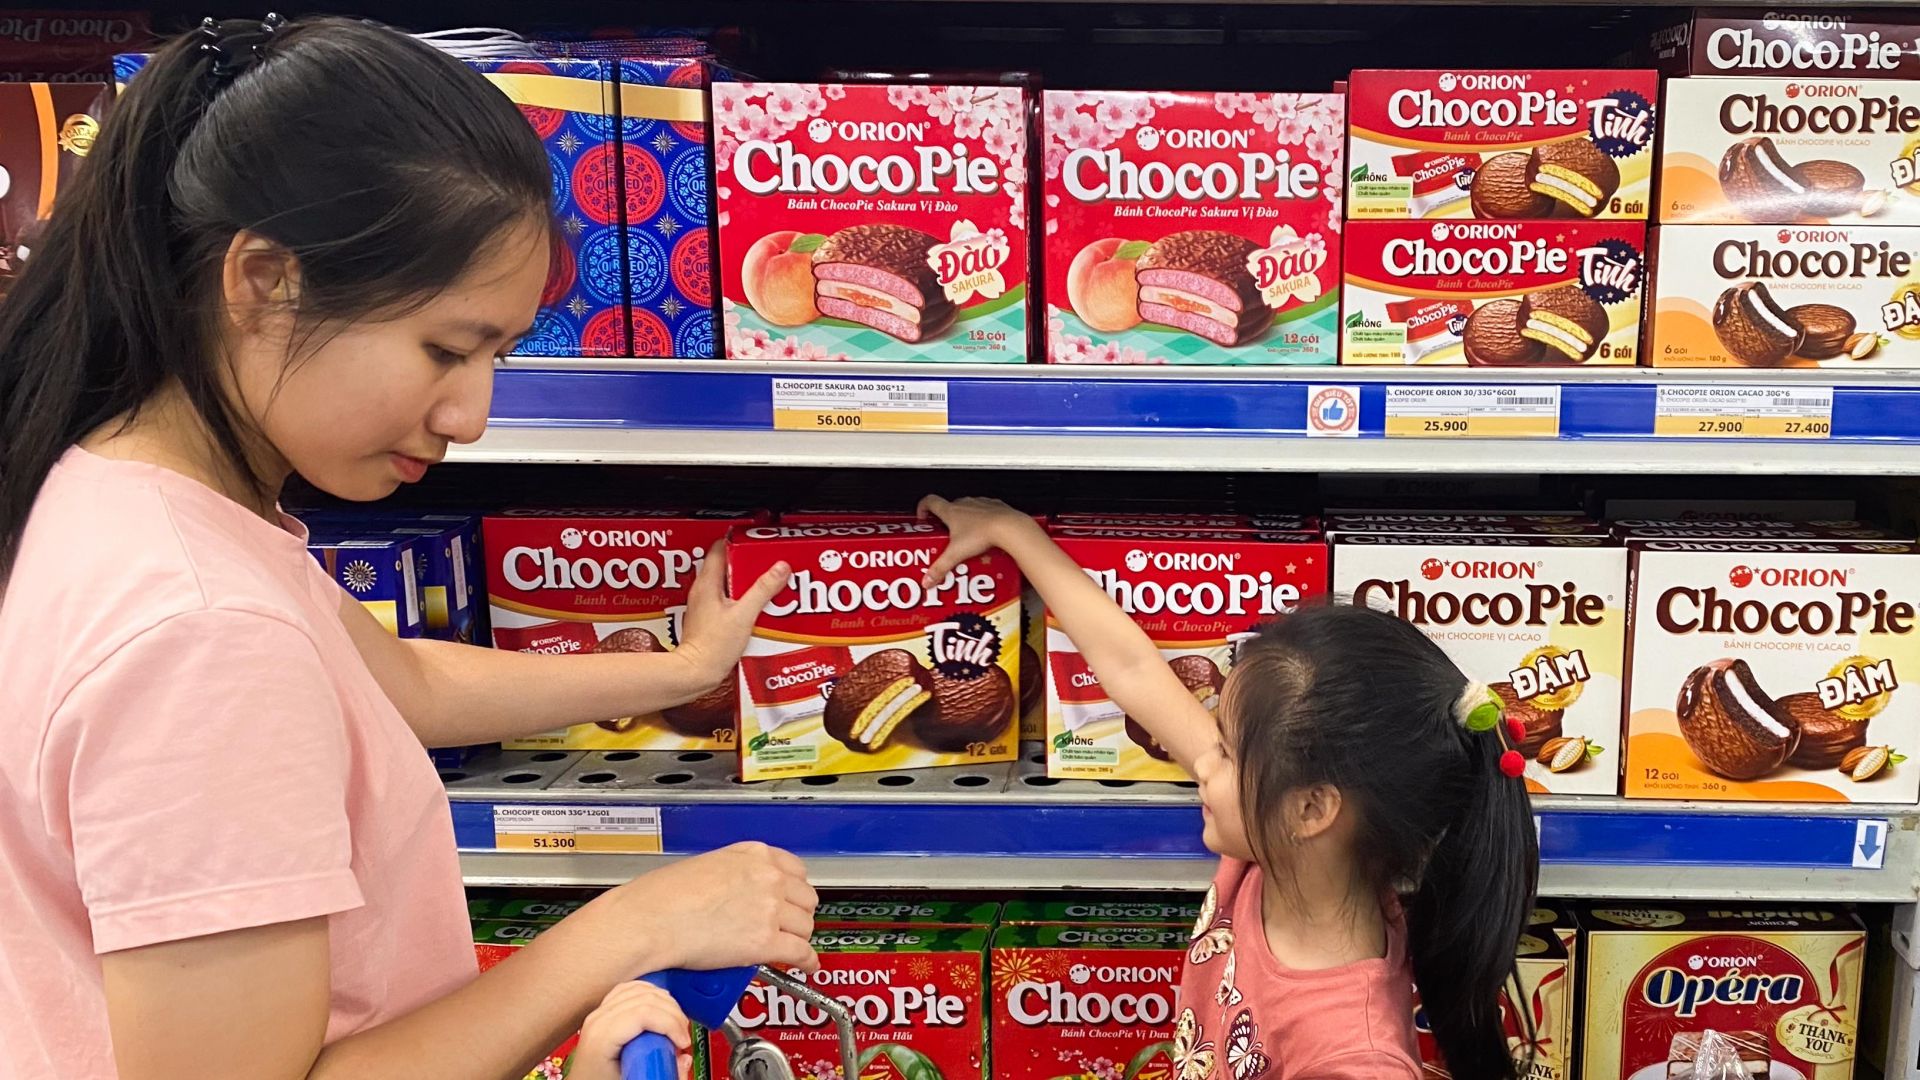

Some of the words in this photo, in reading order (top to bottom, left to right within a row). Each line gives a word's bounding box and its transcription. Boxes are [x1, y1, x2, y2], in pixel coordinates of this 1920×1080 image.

[1706, 27, 1901, 70] ChocoPie
[1462, 75, 1526, 90] ORION
[1804, 85, 1858, 97] ORION
[1388, 89, 1577, 128] ChocoPie
[1719, 94, 1920, 134] ChocoPie
[839, 121, 924, 142] ORION
[1166, 128, 1249, 149] ORION
[1475, 131, 1522, 141] ChocoPie
[733, 140, 999, 194] ChocoPie
[1063, 148, 1319, 201] ChocoPie
[1413, 157, 1465, 182] ChocoPie
[787, 197, 817, 210] Bánh
[820, 198, 874, 212] ChocoPie
[877, 199, 916, 212] Sakura
[920, 200, 932, 214] Vị
[935, 200, 958, 212] Đào
[1114, 206, 1143, 217] Bánh
[1146, 206, 1198, 218] ChocoPie
[1200, 206, 1239, 218] Sakura
[1242, 207, 1254, 220] Vị
[1256, 207, 1279, 218] Đào
[1611, 198, 1622, 213] 6
[1625, 199, 1643, 214] GÓI
[1671, 201, 1679, 210] 6
[1454, 224, 1517, 239] ORION
[1796, 231, 1848, 243] ORION
[937, 243, 1001, 285] Đào
[1382, 239, 1567, 276] ChocoPie
[1713, 239, 1911, 278] ChocoPie
[1257, 248, 1318, 289] Đào
[952, 272, 995, 295] SAKURA
[1269, 276, 1311, 298] SAKURA
[1467, 278, 1514, 289] ChocoPie
[1407, 303, 1458, 328] ChocoPie
[969, 329, 984, 341] 12
[1284, 333, 1298, 343] 12
[1600, 343, 1610, 358] 6
[1614, 344, 1632, 359] GÓI
[1664, 344, 1672, 354] 6
[1738, 389, 1764, 397] CACAO
[817, 415, 861, 426] 56.000
[1424, 420, 1467, 432] 25.900
[1699, 421, 1742, 432] 27.900
[1785, 422, 1829, 433] 27.400
[588, 530, 667, 547] ORION
[849, 549, 930, 569] ORION
[1154, 552, 1234, 571] ORION
[503, 546, 705, 590] ChocoPi
[1451, 561, 1535, 579] ORION
[1761, 568, 1848, 587] ORION
[1656, 586, 1915, 635] ChocoPie
[1173, 620, 1232, 632] ChocoPie
[1448, 632, 1494, 640] CHOCOPIE
[1508, 633, 1541, 641] CACAO
[1724, 640, 1751, 649] BÁNH
[1754, 641, 1803, 650] CHOCOPIE
[1815, 643, 1851, 651] CACAO
[765, 664, 836, 690] ChocoPie
[1510, 650, 1590, 700] ĐẬM
[1817, 659, 1898, 709] ĐẬM
[714, 728, 733, 743] 12
[967, 743, 986, 756] 12
[1645, 768, 1659, 780] 12
[533, 838, 575, 848] 51.300
[1708, 956, 1757, 967] ORION
[813, 968, 890, 985] ORION
[1097, 966, 1172, 982] ORION
[1644, 967, 1803, 1018] Opéra
[1007, 981, 1181, 1025] Choco
[779, 1032, 804, 1041] Bánh
[869, 1032, 889, 1041] Dưa
[1061, 1029, 1085, 1038] Bánh
[1088, 1029, 1133, 1039] ChocoPie
[1136, 1030, 1146, 1041] Vị
[1149, 1030, 1170, 1039] Dưa
[1799, 1023, 1848, 1044] THANK
[1805, 1037, 1834, 1053] YOU
